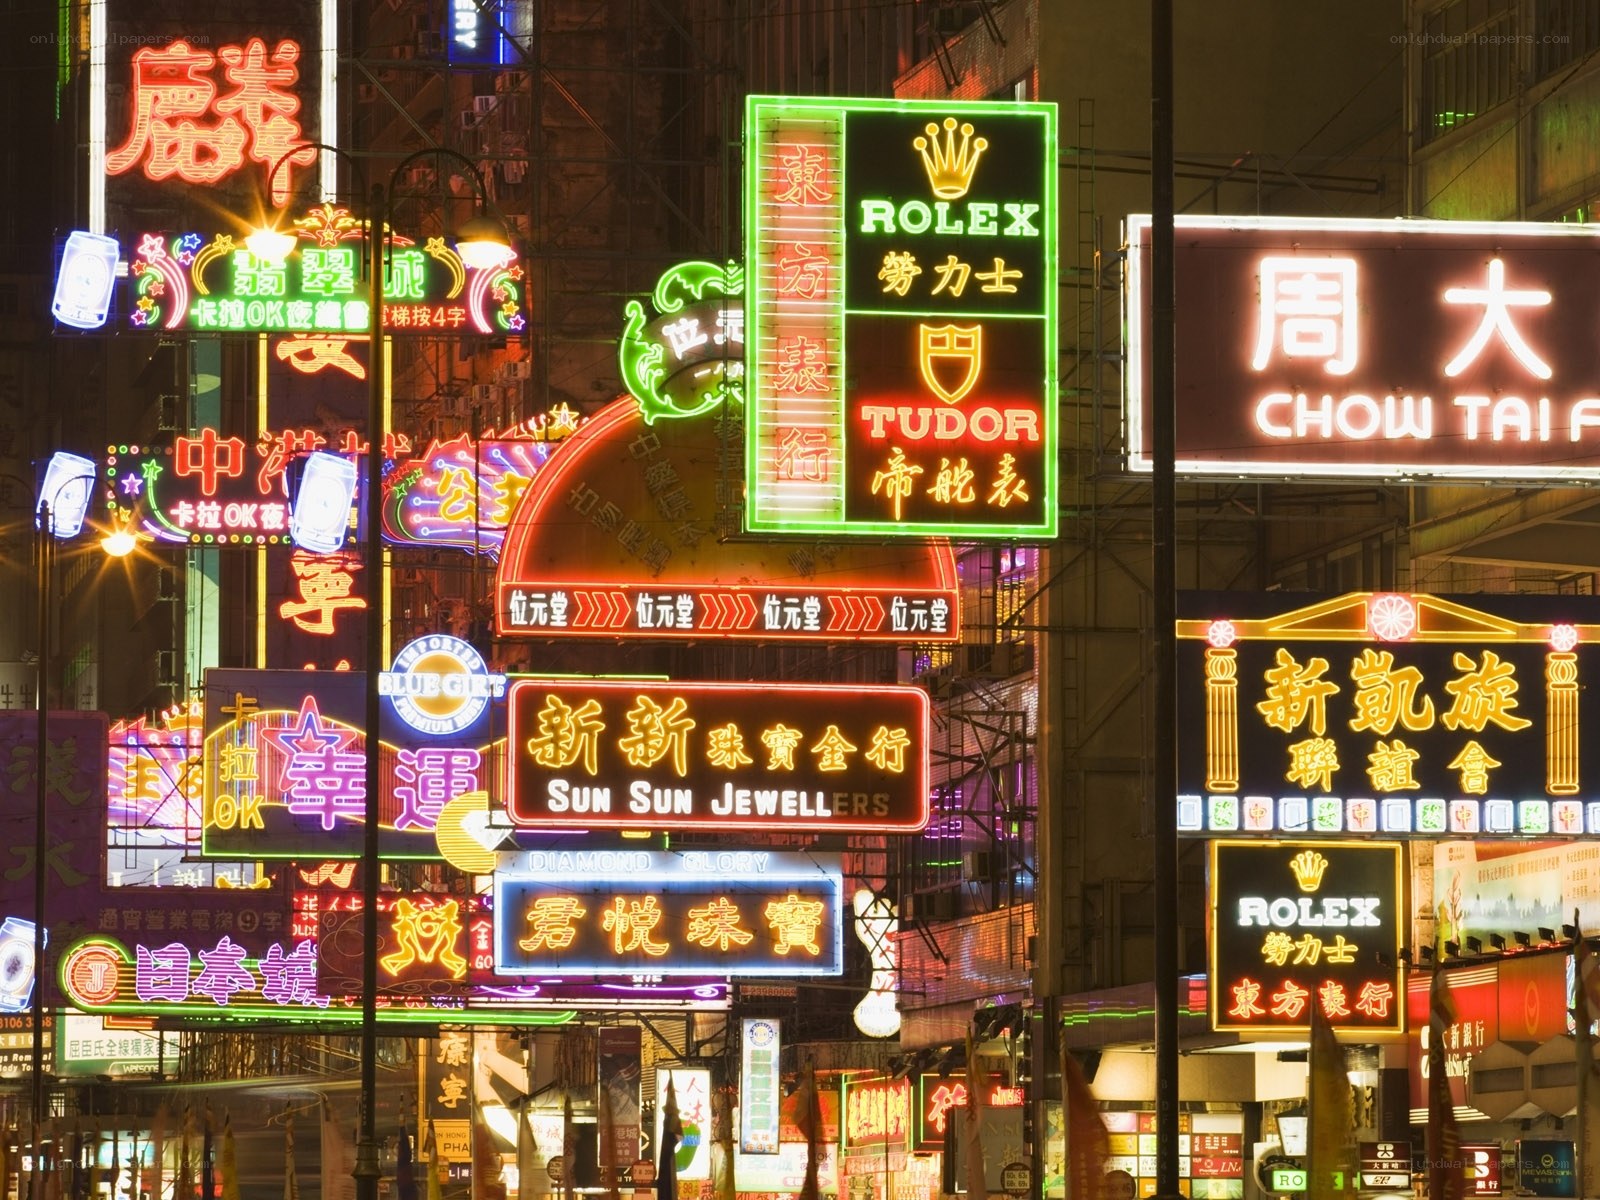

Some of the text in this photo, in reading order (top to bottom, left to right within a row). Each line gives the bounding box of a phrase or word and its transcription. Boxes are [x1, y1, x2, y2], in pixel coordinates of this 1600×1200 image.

[861, 200, 1039, 236] ROLEX
[878, 251, 1023, 297] 勞力士
[773, 145, 833, 482] 東方表行
[1251, 256, 1553, 380] 周大
[862, 405, 1040, 442] TUDOR
[1256, 393, 1432, 439] CHOW
[1453, 396, 1549, 441] TAI
[872, 447, 1030, 521] 帝舵表
[509, 589, 568, 628] 位元堂
[636, 591, 694, 630] 位元堂
[763, 593, 822, 632] 位元堂
[890, 595, 949, 634] 位元堂
[378, 672, 440, 697] BLUE
[1256, 648, 1533, 737] 新凱旋
[527, 694, 911, 777] 新新珠寶金行
[1285, 738, 1502, 795] 聯誼會
[287, 746, 481, 831] 幸運
[528, 851, 769, 872] DIAMOND GLORY
[518, 895, 825, 956] 君悅珠寶
[1238, 897, 1381, 927] ROLEX
[471, 920, 492, 950] 金
[1261, 932, 1358, 966] 勞力士
[1229, 978, 1393, 1019] 東方表行
